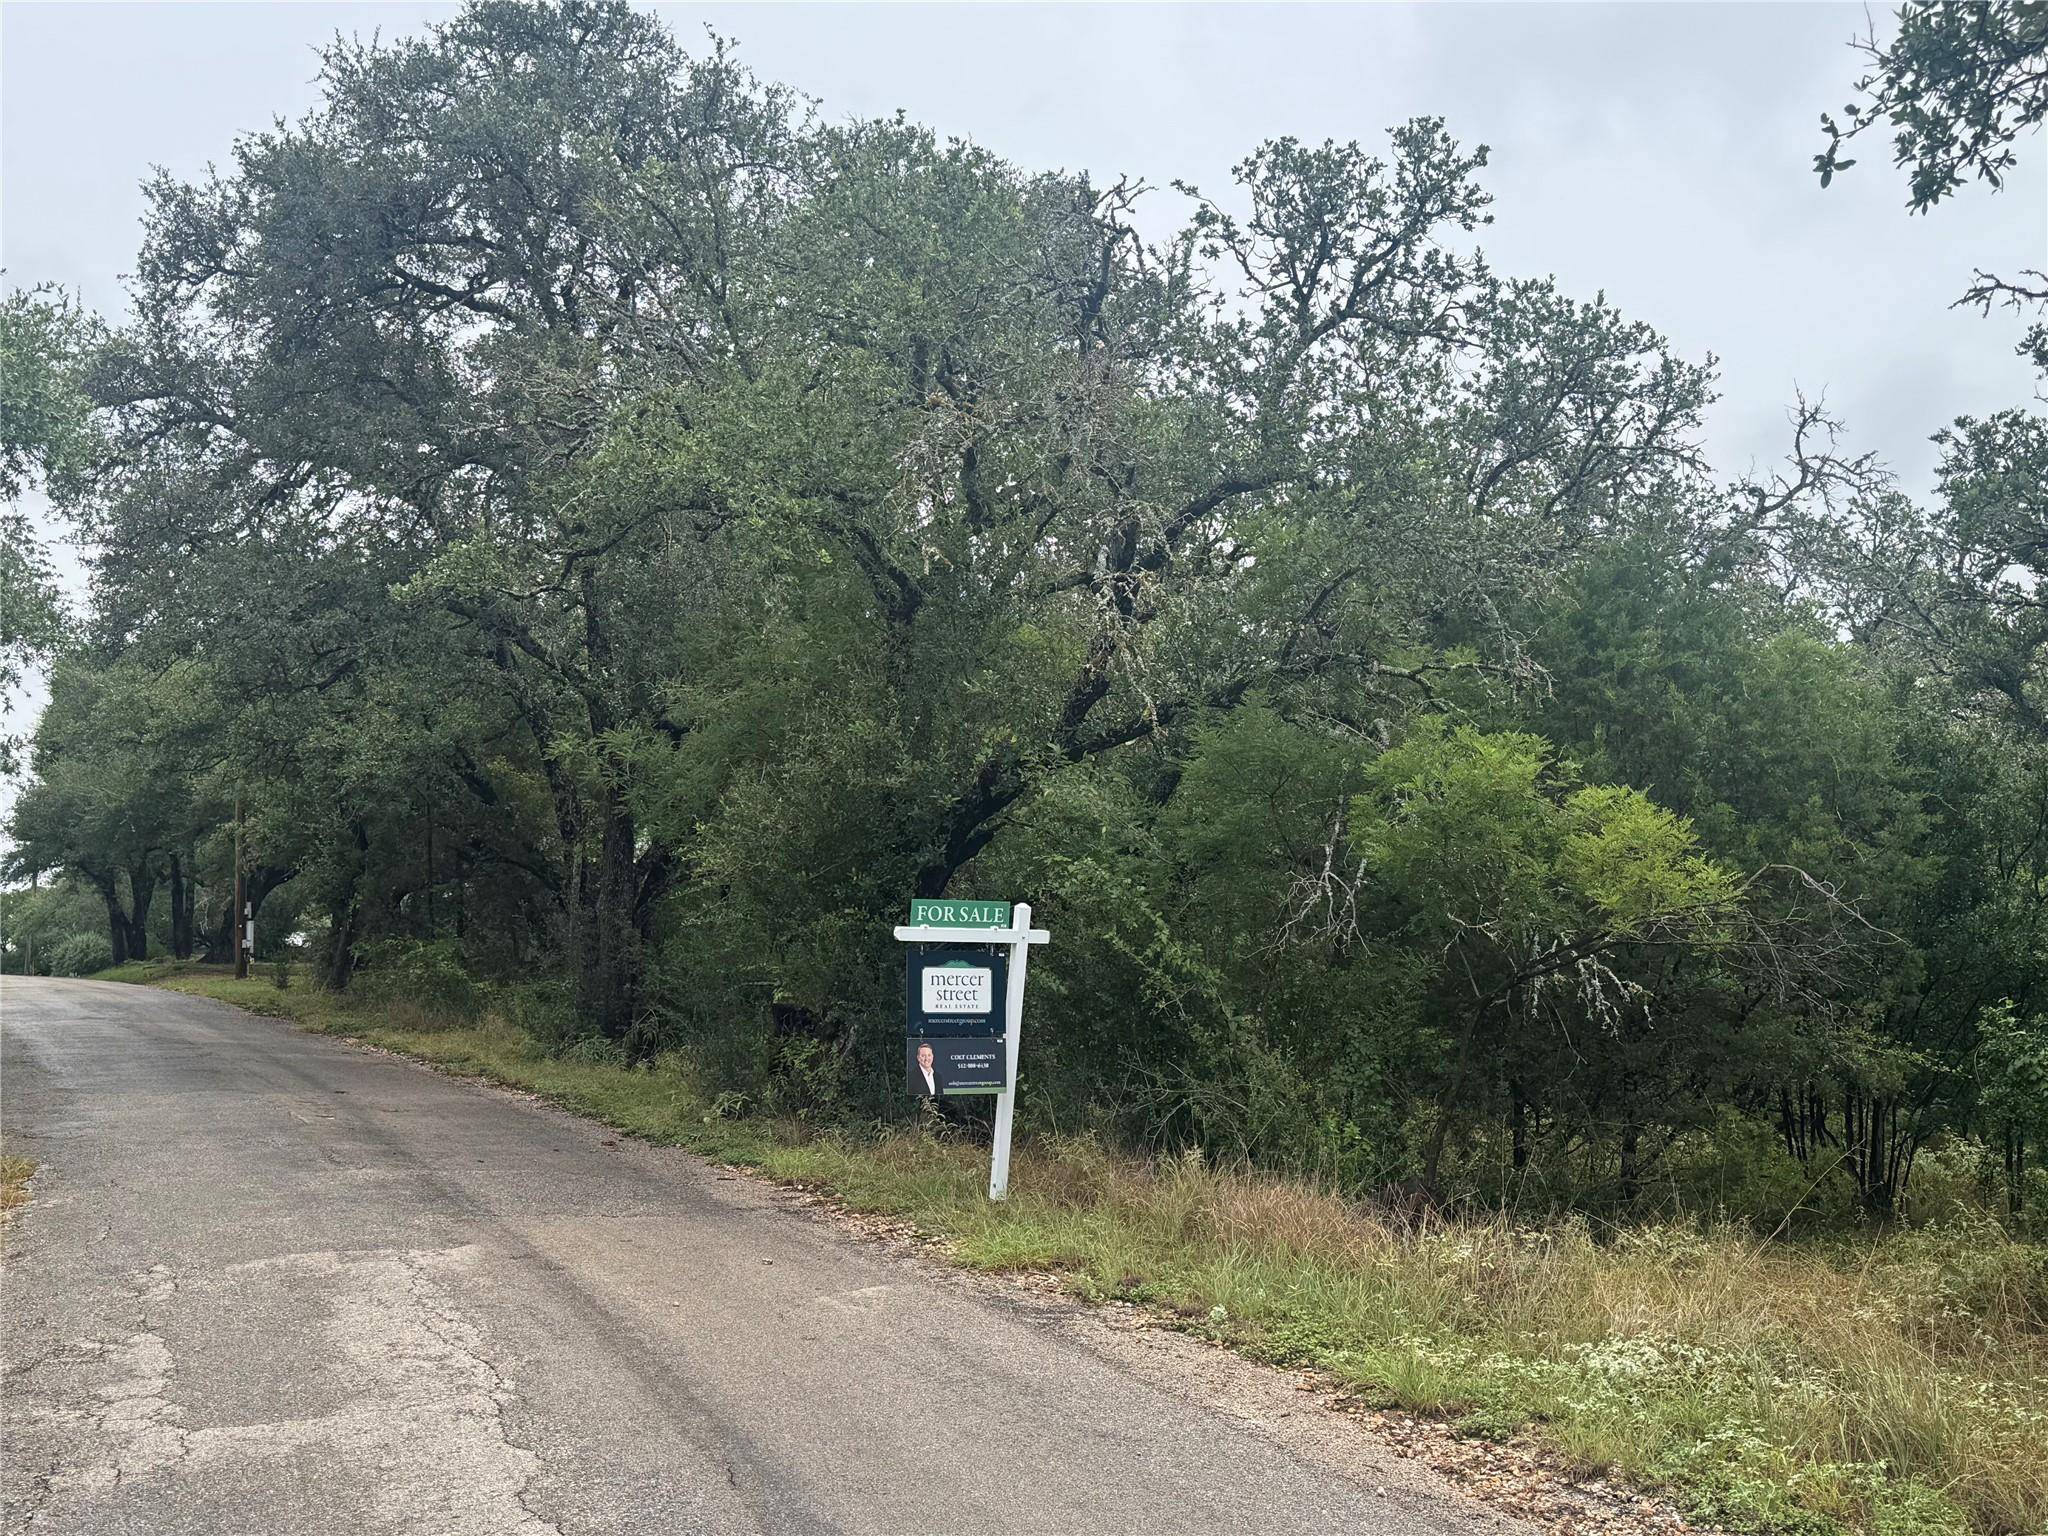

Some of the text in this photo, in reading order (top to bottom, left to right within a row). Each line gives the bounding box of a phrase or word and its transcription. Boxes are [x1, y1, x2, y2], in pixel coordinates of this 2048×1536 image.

[917, 905, 1004, 923] FOR SALE
[930, 974, 984, 986] mercer
[936, 988, 978, 1001] street
